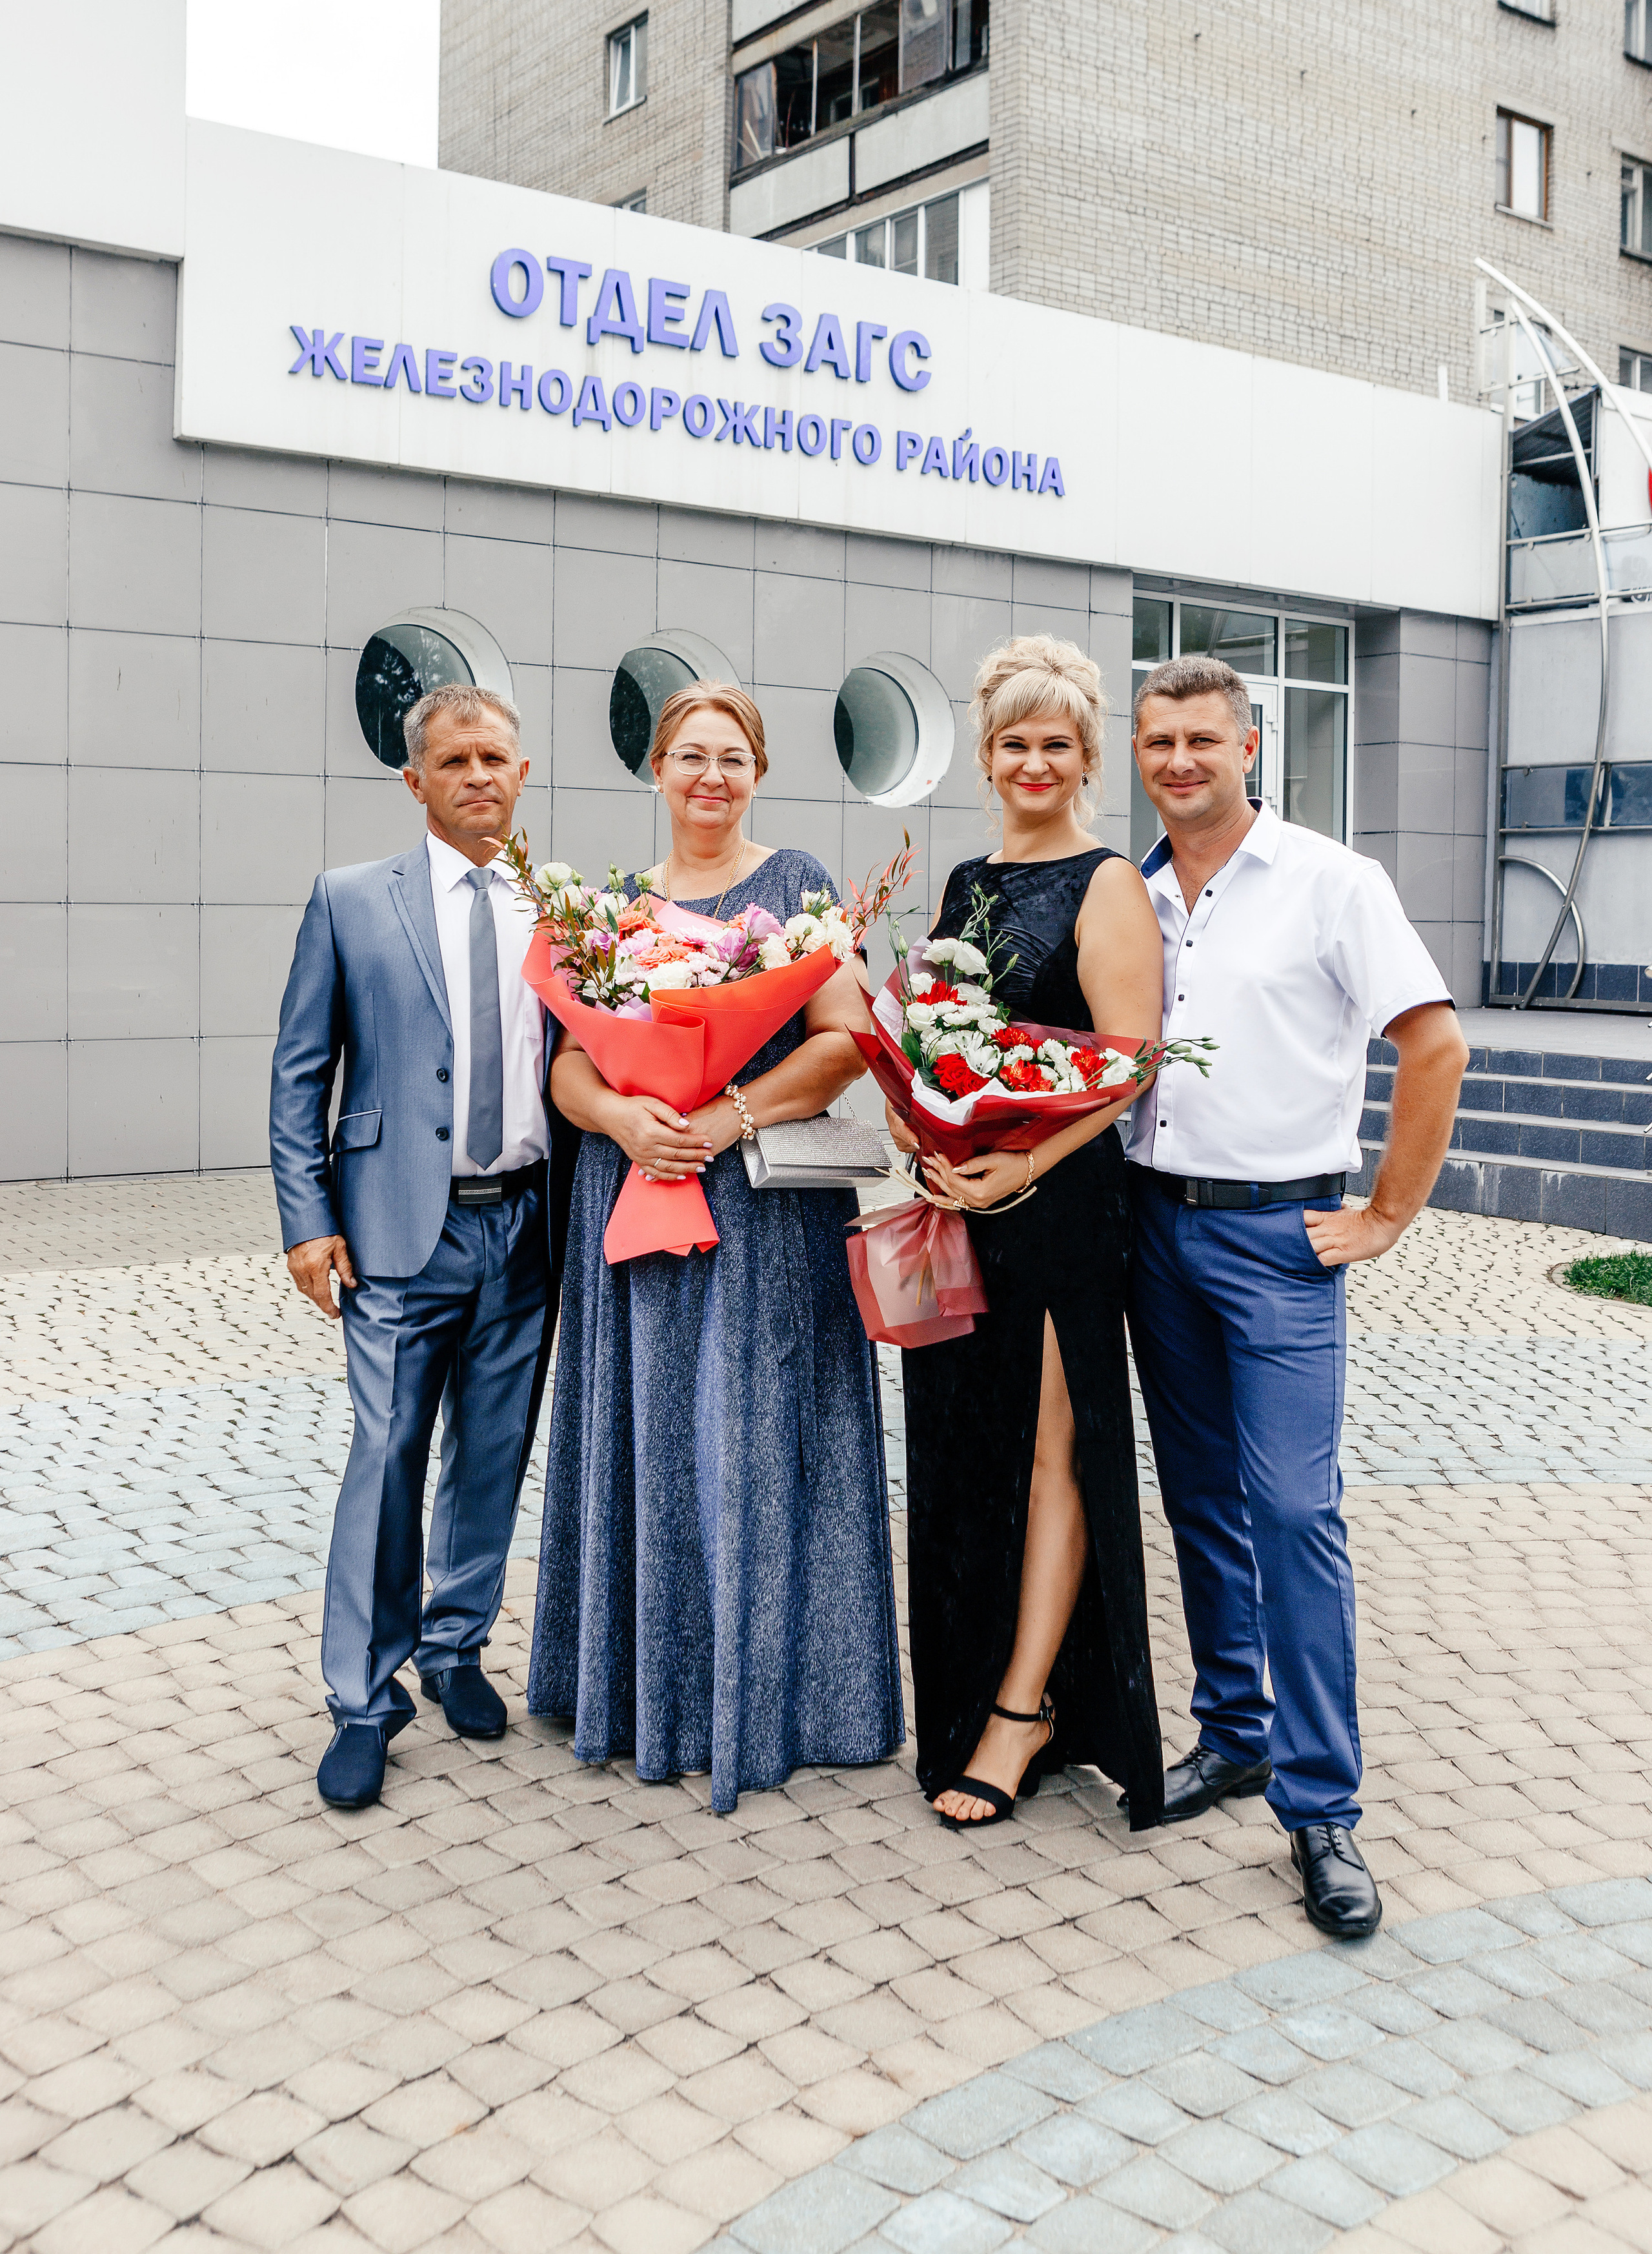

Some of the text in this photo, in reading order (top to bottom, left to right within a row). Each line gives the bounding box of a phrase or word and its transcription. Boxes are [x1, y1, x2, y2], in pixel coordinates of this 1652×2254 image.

[490, 248, 932, 393] ОТДЕЛ ЗАГС
[289, 325, 1065, 497] ЖЕЛЕЗНОДОРОЖНОГО РАЙОНА
